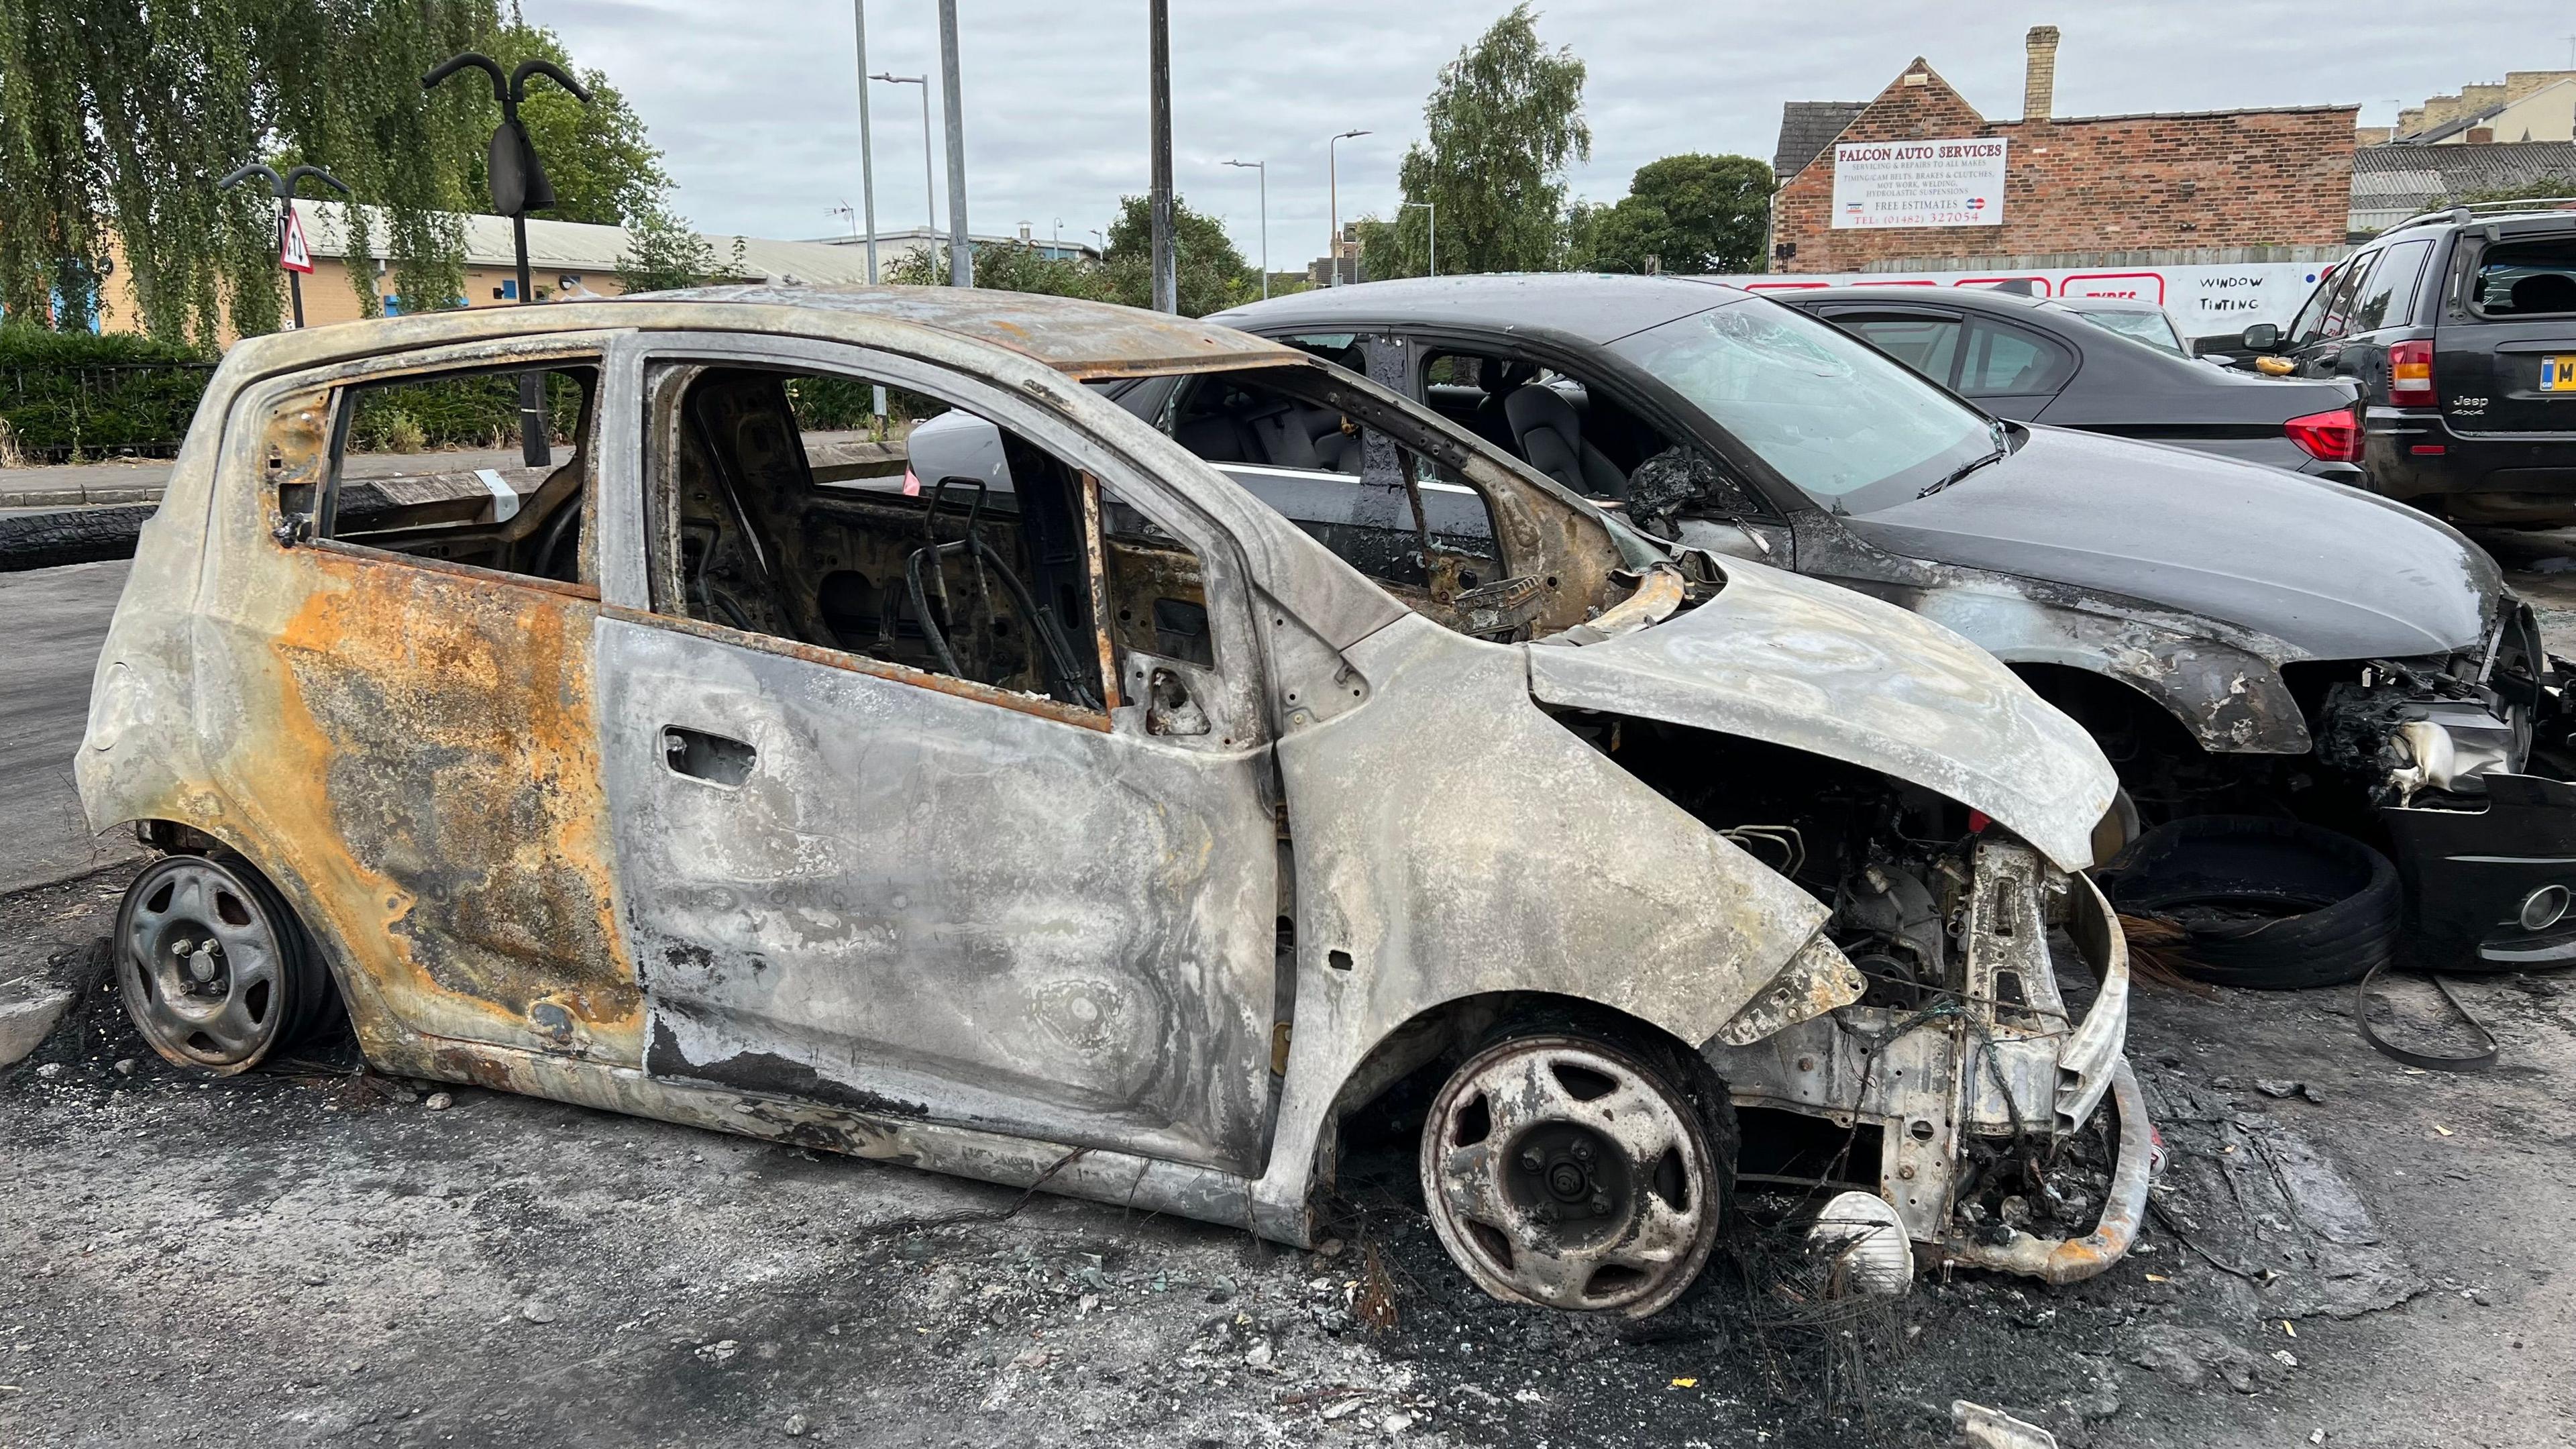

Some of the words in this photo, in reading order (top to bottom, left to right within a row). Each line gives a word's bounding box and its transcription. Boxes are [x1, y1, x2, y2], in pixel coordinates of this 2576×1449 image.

[1839, 148, 1892, 162] FALCON
[1895, 146, 1933, 160] AUTO
[1939, 144, 2002, 158] SERVICES
[1852, 162, 1891, 170] SERVICING
[1901, 160, 1931, 168] REPAIRS
[1961, 159, 1986, 167] MAKES
[1866, 189, 1917, 197] HYDROLASTIC
[1919, 187, 1969, 196] SUSPENSIONS
[1876, 202, 1899, 211] FREE
[1902, 200, 1957, 210] ESTIMATES
[1854, 216, 1879, 225] TEL:
[1884, 215, 1924, 224] (01482)
[1931, 212, 1979, 223] 327054
[2200, 277, 2263, 288] WINDOW
[2559, 363, 2574, 382] M
[2453, 395, 2489, 408] Jeep
